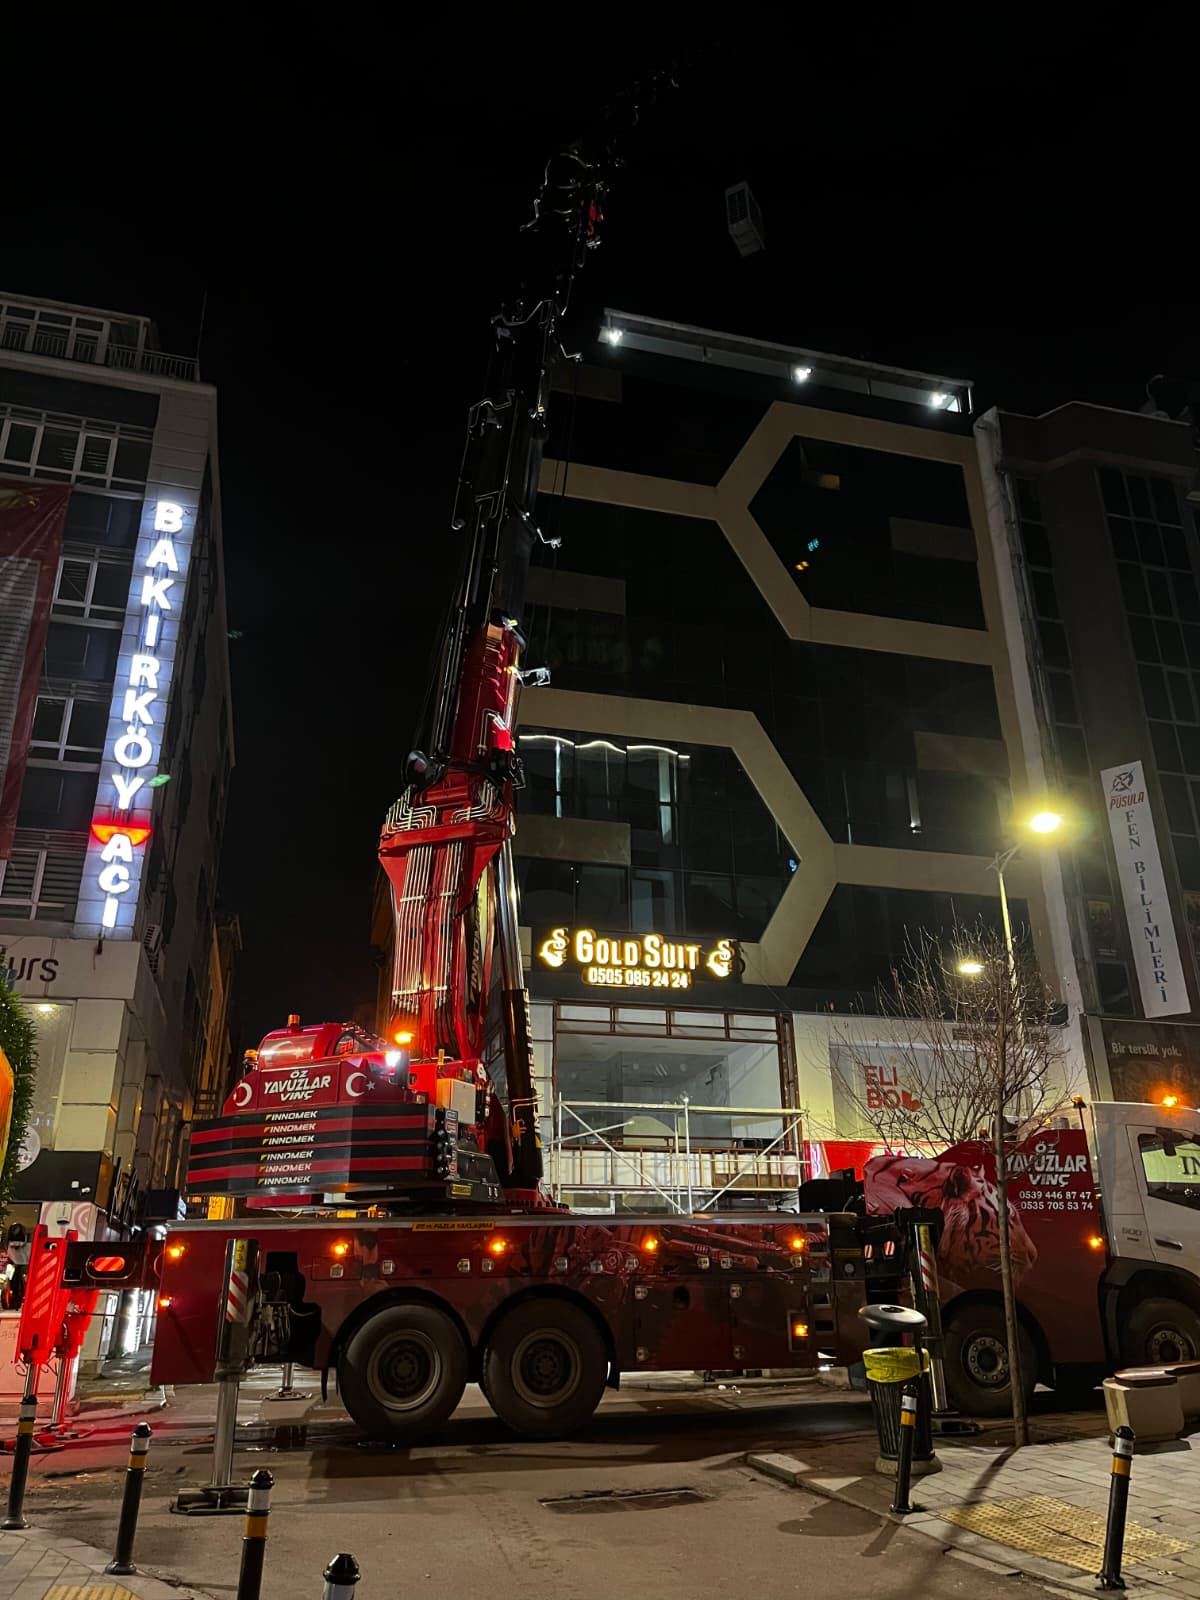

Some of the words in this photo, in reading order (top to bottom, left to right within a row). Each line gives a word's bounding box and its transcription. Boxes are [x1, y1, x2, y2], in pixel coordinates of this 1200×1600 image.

[112, 501, 184, 811] BAKIRKÖY
[1110, 791, 1145, 811] PUSULA
[1125, 809, 1141, 850] FEN
[588, 967, 623, 984] 0505
[625, 969, 650, 986] 085
[652, 971, 669, 987] 24
[671, 972, 689, 989] 24
[290, 1070, 308, 1079] ÖZ
[264, 1075, 331, 1094] YAVUZLAR
[271, 1110, 318, 1120] INNOMEK
[270, 1123, 317, 1133] INNOMEK
[268, 1135, 315, 1145] INNOMEK
[267, 1150, 314, 1160] INNOMEK
[264, 1162, 312, 1173] INNOMEK
[264, 1175, 311, 1185] INNOMEK
[1019, 1190, 1043, 1200] 0539
[1045, 1191, 1063, 1200] 446
[1065, 1191, 1077, 1200] 87
[1079, 1191, 1092, 1200] 47
[1020, 1201, 1045, 1210] 0535
[1047, 1201, 1065, 1210] 705
[1067, 1201, 1079, 1210] 53
[1081, 1201, 1093, 1210] 74
